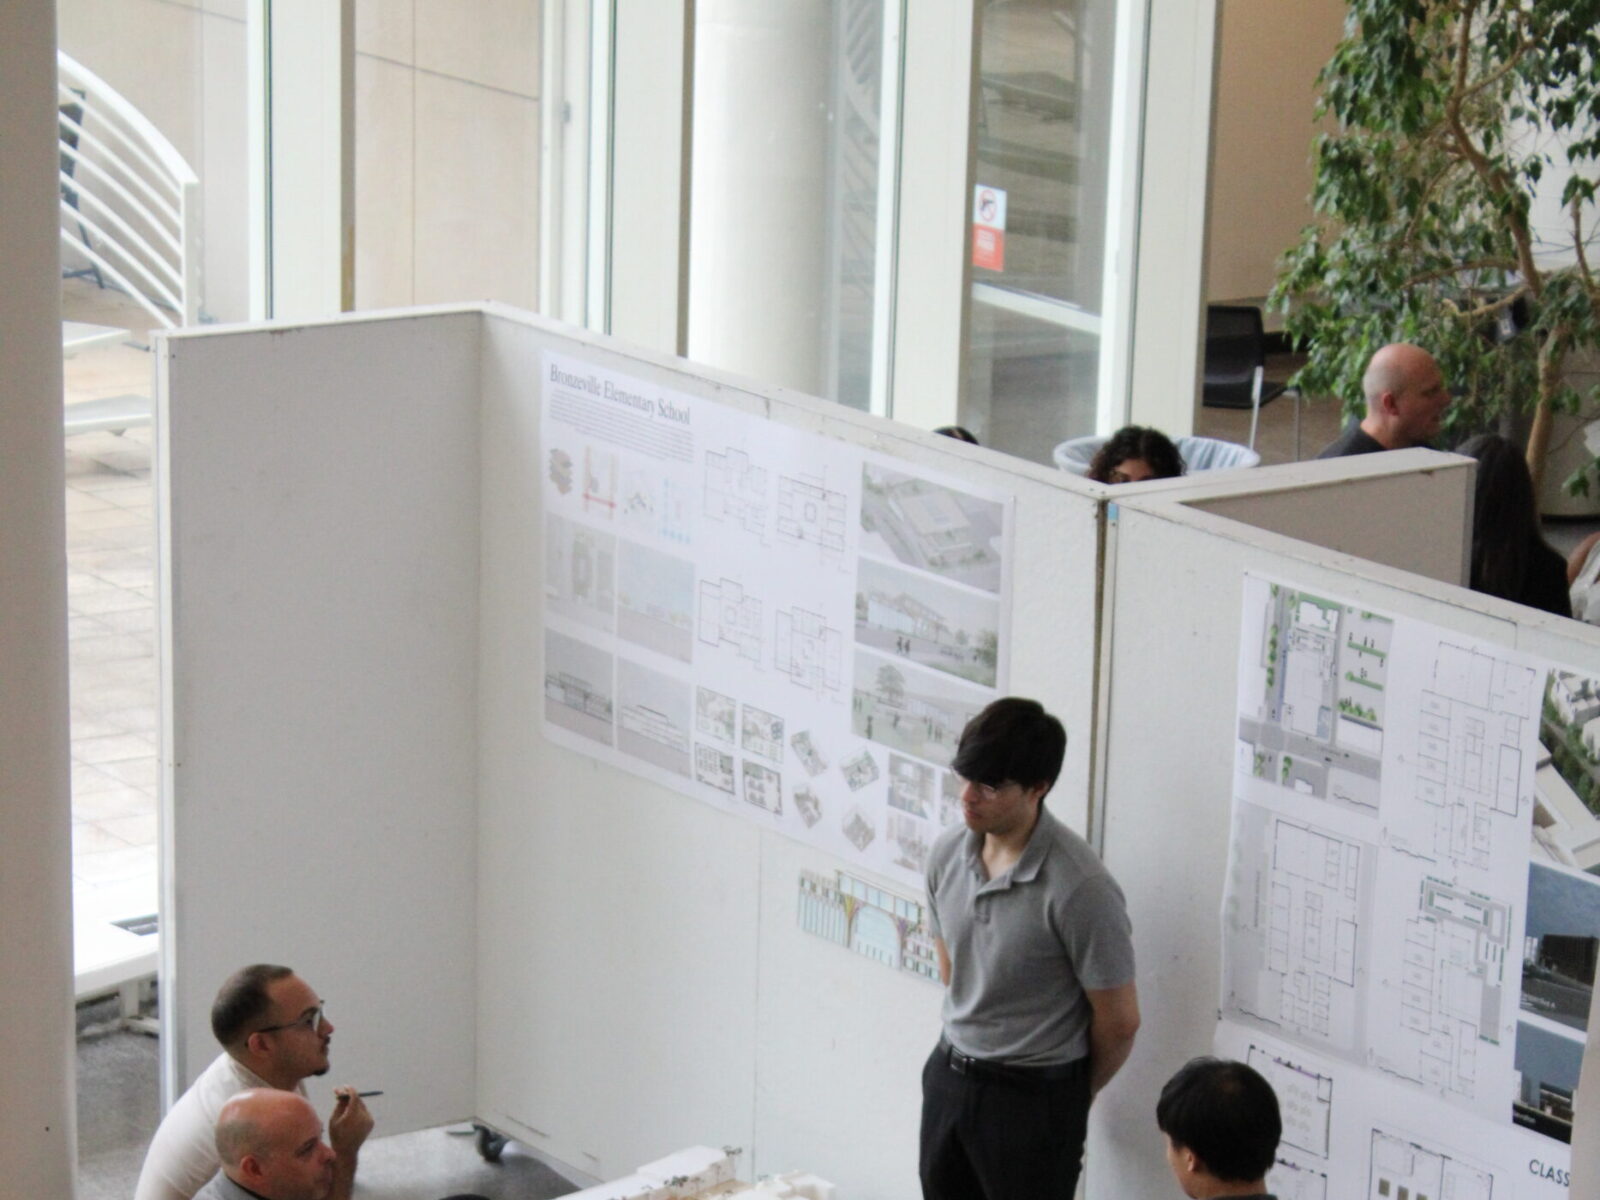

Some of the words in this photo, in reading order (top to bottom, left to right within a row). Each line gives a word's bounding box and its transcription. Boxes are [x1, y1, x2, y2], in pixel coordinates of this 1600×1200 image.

[550, 363, 600, 396] Bronzeville
[604, 380, 655, 418] Elementary
[658, 398, 690, 425] School
[1529, 1159, 1570, 1187] CLASS
